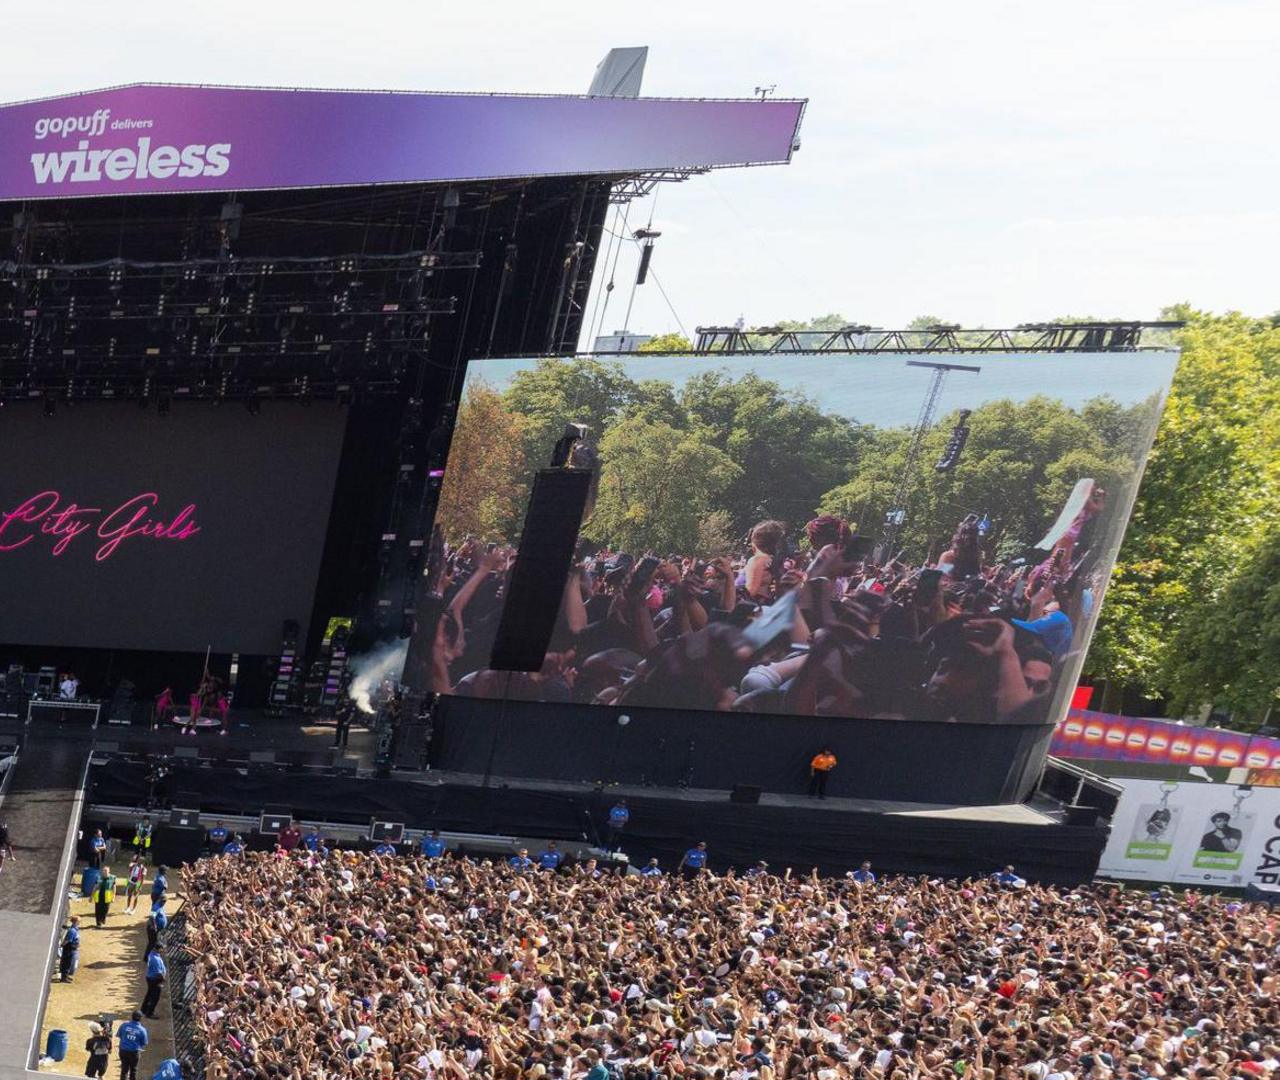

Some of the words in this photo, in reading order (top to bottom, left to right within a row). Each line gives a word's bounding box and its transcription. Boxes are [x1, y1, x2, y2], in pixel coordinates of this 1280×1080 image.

[35, 109, 111, 139] gopuff
[111, 118, 153, 130] delivers
[30, 137, 232, 184] wireless
[95, 493, 200, 561] Girls
